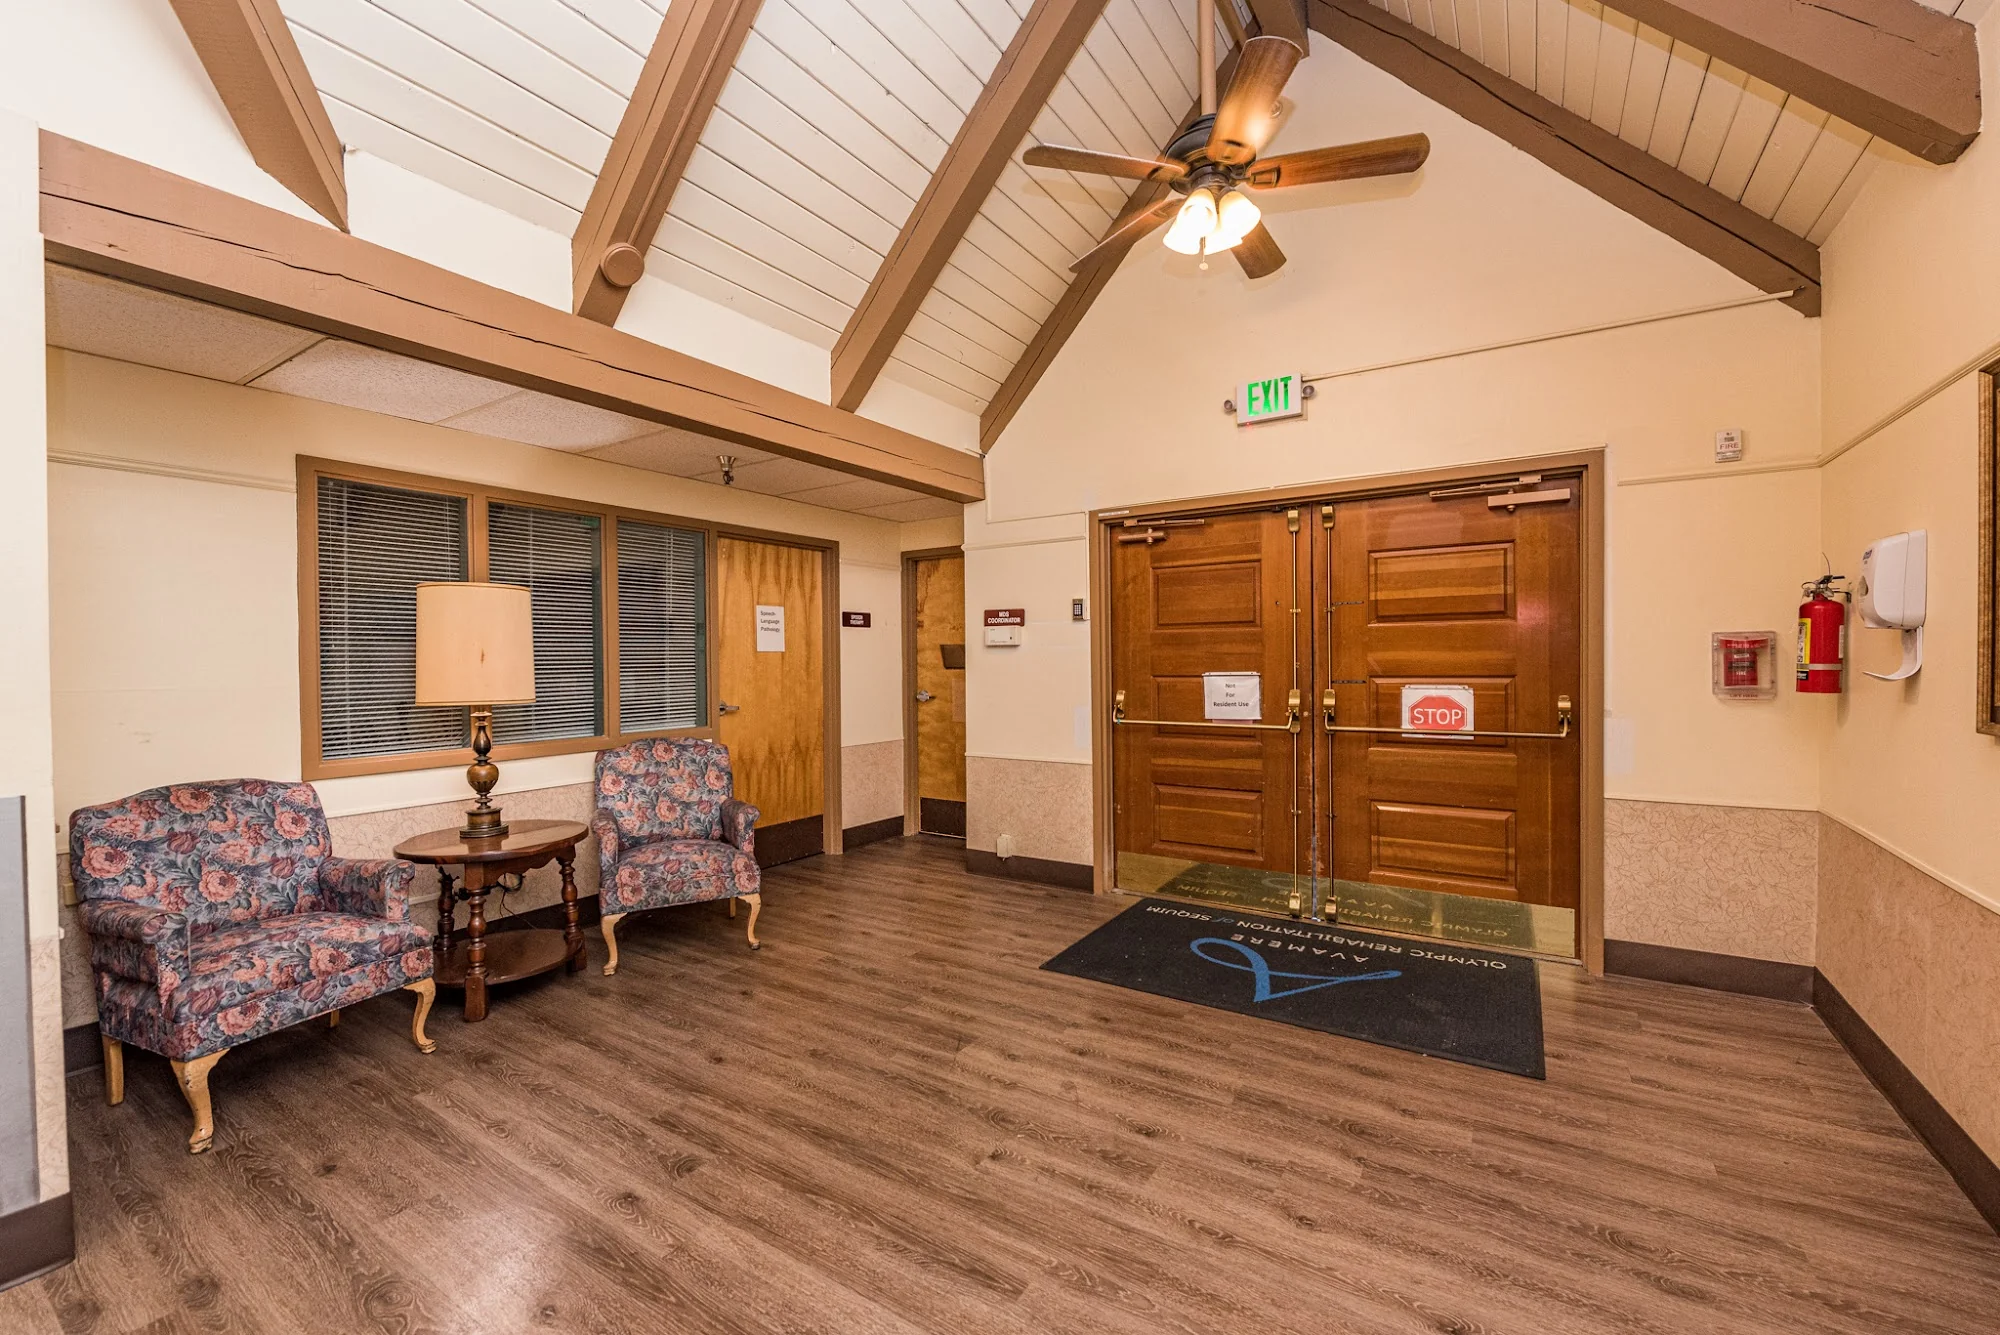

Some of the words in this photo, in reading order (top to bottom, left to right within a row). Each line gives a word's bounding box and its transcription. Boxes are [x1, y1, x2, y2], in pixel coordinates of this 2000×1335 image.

[1247, 375, 1292, 417] EXIT
[1720, 442, 1739, 450] FIRE
[1413, 708, 1462, 725] STOP
[1146, 905, 1212, 921] SEQUIM
[1236, 920, 1402, 954] REHABILITATION
[1230, 933, 1369, 963] AVAMERE
[1410, 949, 1507, 970] OLYMPIC
